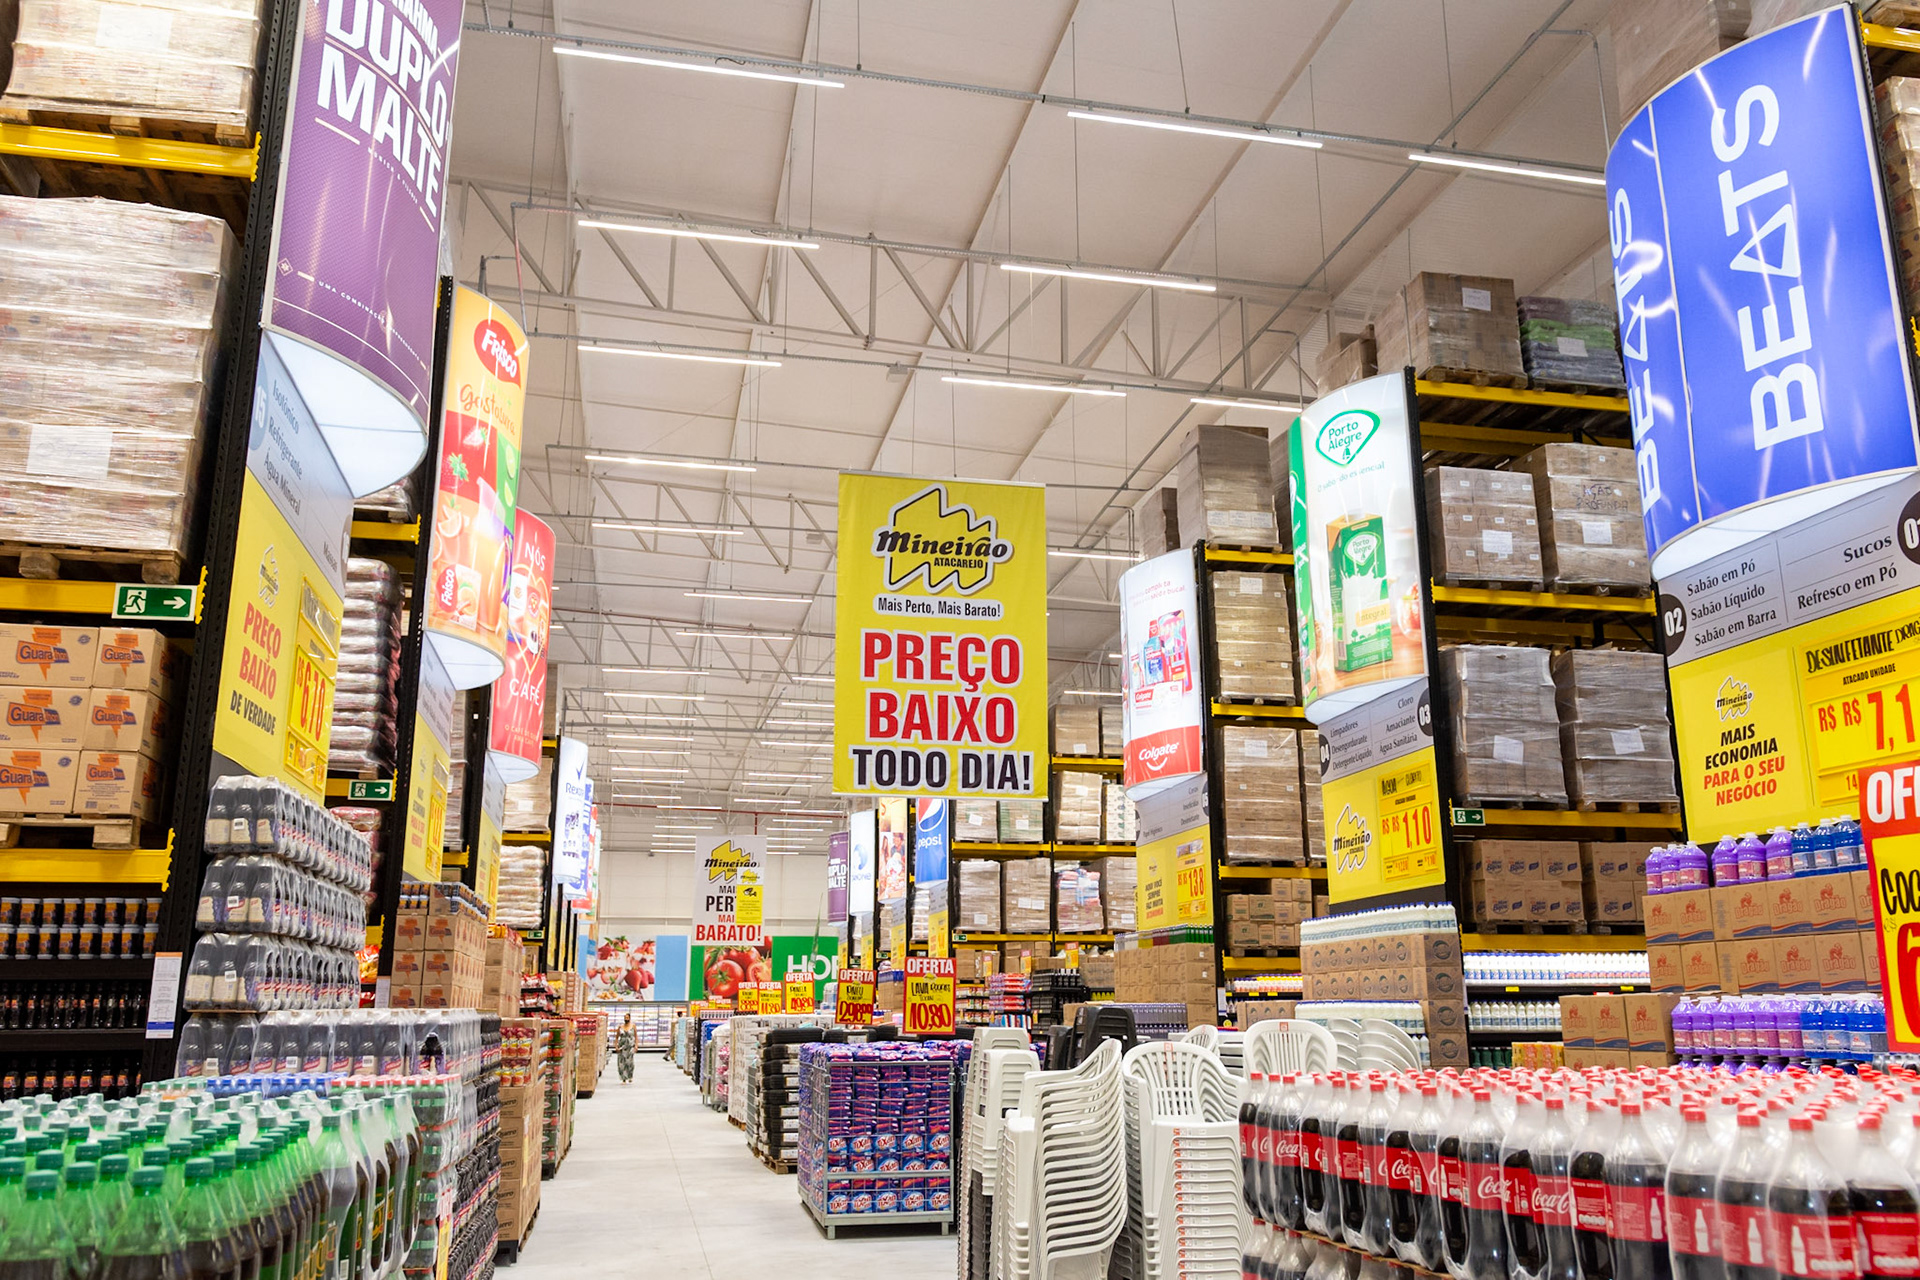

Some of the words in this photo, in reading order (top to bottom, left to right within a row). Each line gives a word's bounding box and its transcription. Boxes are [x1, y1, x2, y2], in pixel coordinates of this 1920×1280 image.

[325, 0, 448, 149] DUPLO
[317, 43, 442, 218] MALTE
[1711, 84, 1825, 451] BEATS
[1328, 431, 1362, 452] Alegre
[1329, 422, 1358, 440] Porto
[269, 416, 303, 481] Refrigerante
[263, 447, 280, 486] Água
[280, 474, 301, 517] Mineral
[524, 541, 546, 572] NÓS
[876, 530, 1009, 559] Mineirão
[1843, 535, 1892, 563] Sucos
[934, 557, 984, 570] ATACAREJO
[1687, 575, 1719, 597] Sabão
[1721, 567, 1739, 584] em
[1741, 558, 1756, 575] Pó
[1797, 580, 1851, 610] Refresco
[1854, 571, 1876, 591] em
[1879, 562, 1898, 584] Pó
[878, 597, 903, 613] Mais
[905, 600, 935, 616] Perto,
[938, 601, 962, 617] Mais
[965, 603, 1001, 618] Barato!
[1690, 601, 1722, 622] Sabão
[1725, 584, 1766, 611] Líquido
[243, 602, 282, 664] PREÇO
[1664, 607, 1685, 637] 02
[1694, 626, 1726, 647] Sabão
[1728, 619, 1746, 635] em
[1748, 609, 1777, 628] Barra
[1806, 629, 1895, 674] DESINFETANTE
[1894, 619, 1920, 645] DRAG
[239, 646, 278, 701] BAIXO
[864, 631, 1020, 693] PREÇO
[1843, 671, 1869, 686] ATACADO
[1869, 663, 1896, 679] UNIDADE
[229, 690, 242, 716] DE
[243, 697, 277, 736] VERDADE
[1398, 696, 1414, 709] Cloro
[1716, 691, 1753, 709] Mineirão
[869, 692, 1015, 744] BAIXO
[1386, 714, 1416, 734] Amaciante
[1419, 704, 1431, 727] 03
[1818, 704, 1837, 732] R$
[1843, 697, 1862, 727] R$
[1330, 721, 1358, 738] Limpadores
[1393, 732, 1418, 749] Sanitária
[1720, 723, 1756, 747] MAIS
[1138, 742, 1178, 761] Colgate
[1320, 743, 1330, 763] 04
[1332, 734, 1368, 755] Desengordurante
[1705, 738, 1778, 770] ECONOMIA
[852, 749, 947, 788] TODO
[961, 753, 1031, 791] DIA!
[1332, 755, 1356, 770] Detergente
[1355, 748, 1373, 762] Líquido
[1703, 766, 1740, 791] PARA
[1744, 763, 1754, 780] O
[1758, 755, 1785, 777] SEU
[1716, 778, 1777, 807] NEGÓCIO
[1402, 805, 1432, 850] 1,10
[918, 834, 942, 850] pepsi
[1333, 831, 1371, 853] Mineirão
[704, 858, 757, 868] Mineirão
[706, 895, 737, 912] PER
[719, 886, 737, 894] MAI
[718, 914, 735, 923] MAI
[695, 924, 762, 942] BARATO!
[786, 972, 813, 982] OFERTA
[840, 969, 874, 982] OFERTA
[907, 958, 954, 974] OFERTA
[910, 1002, 951, 1030] 10,80
[1532, 1187, 1570, 1215] Coca-C
